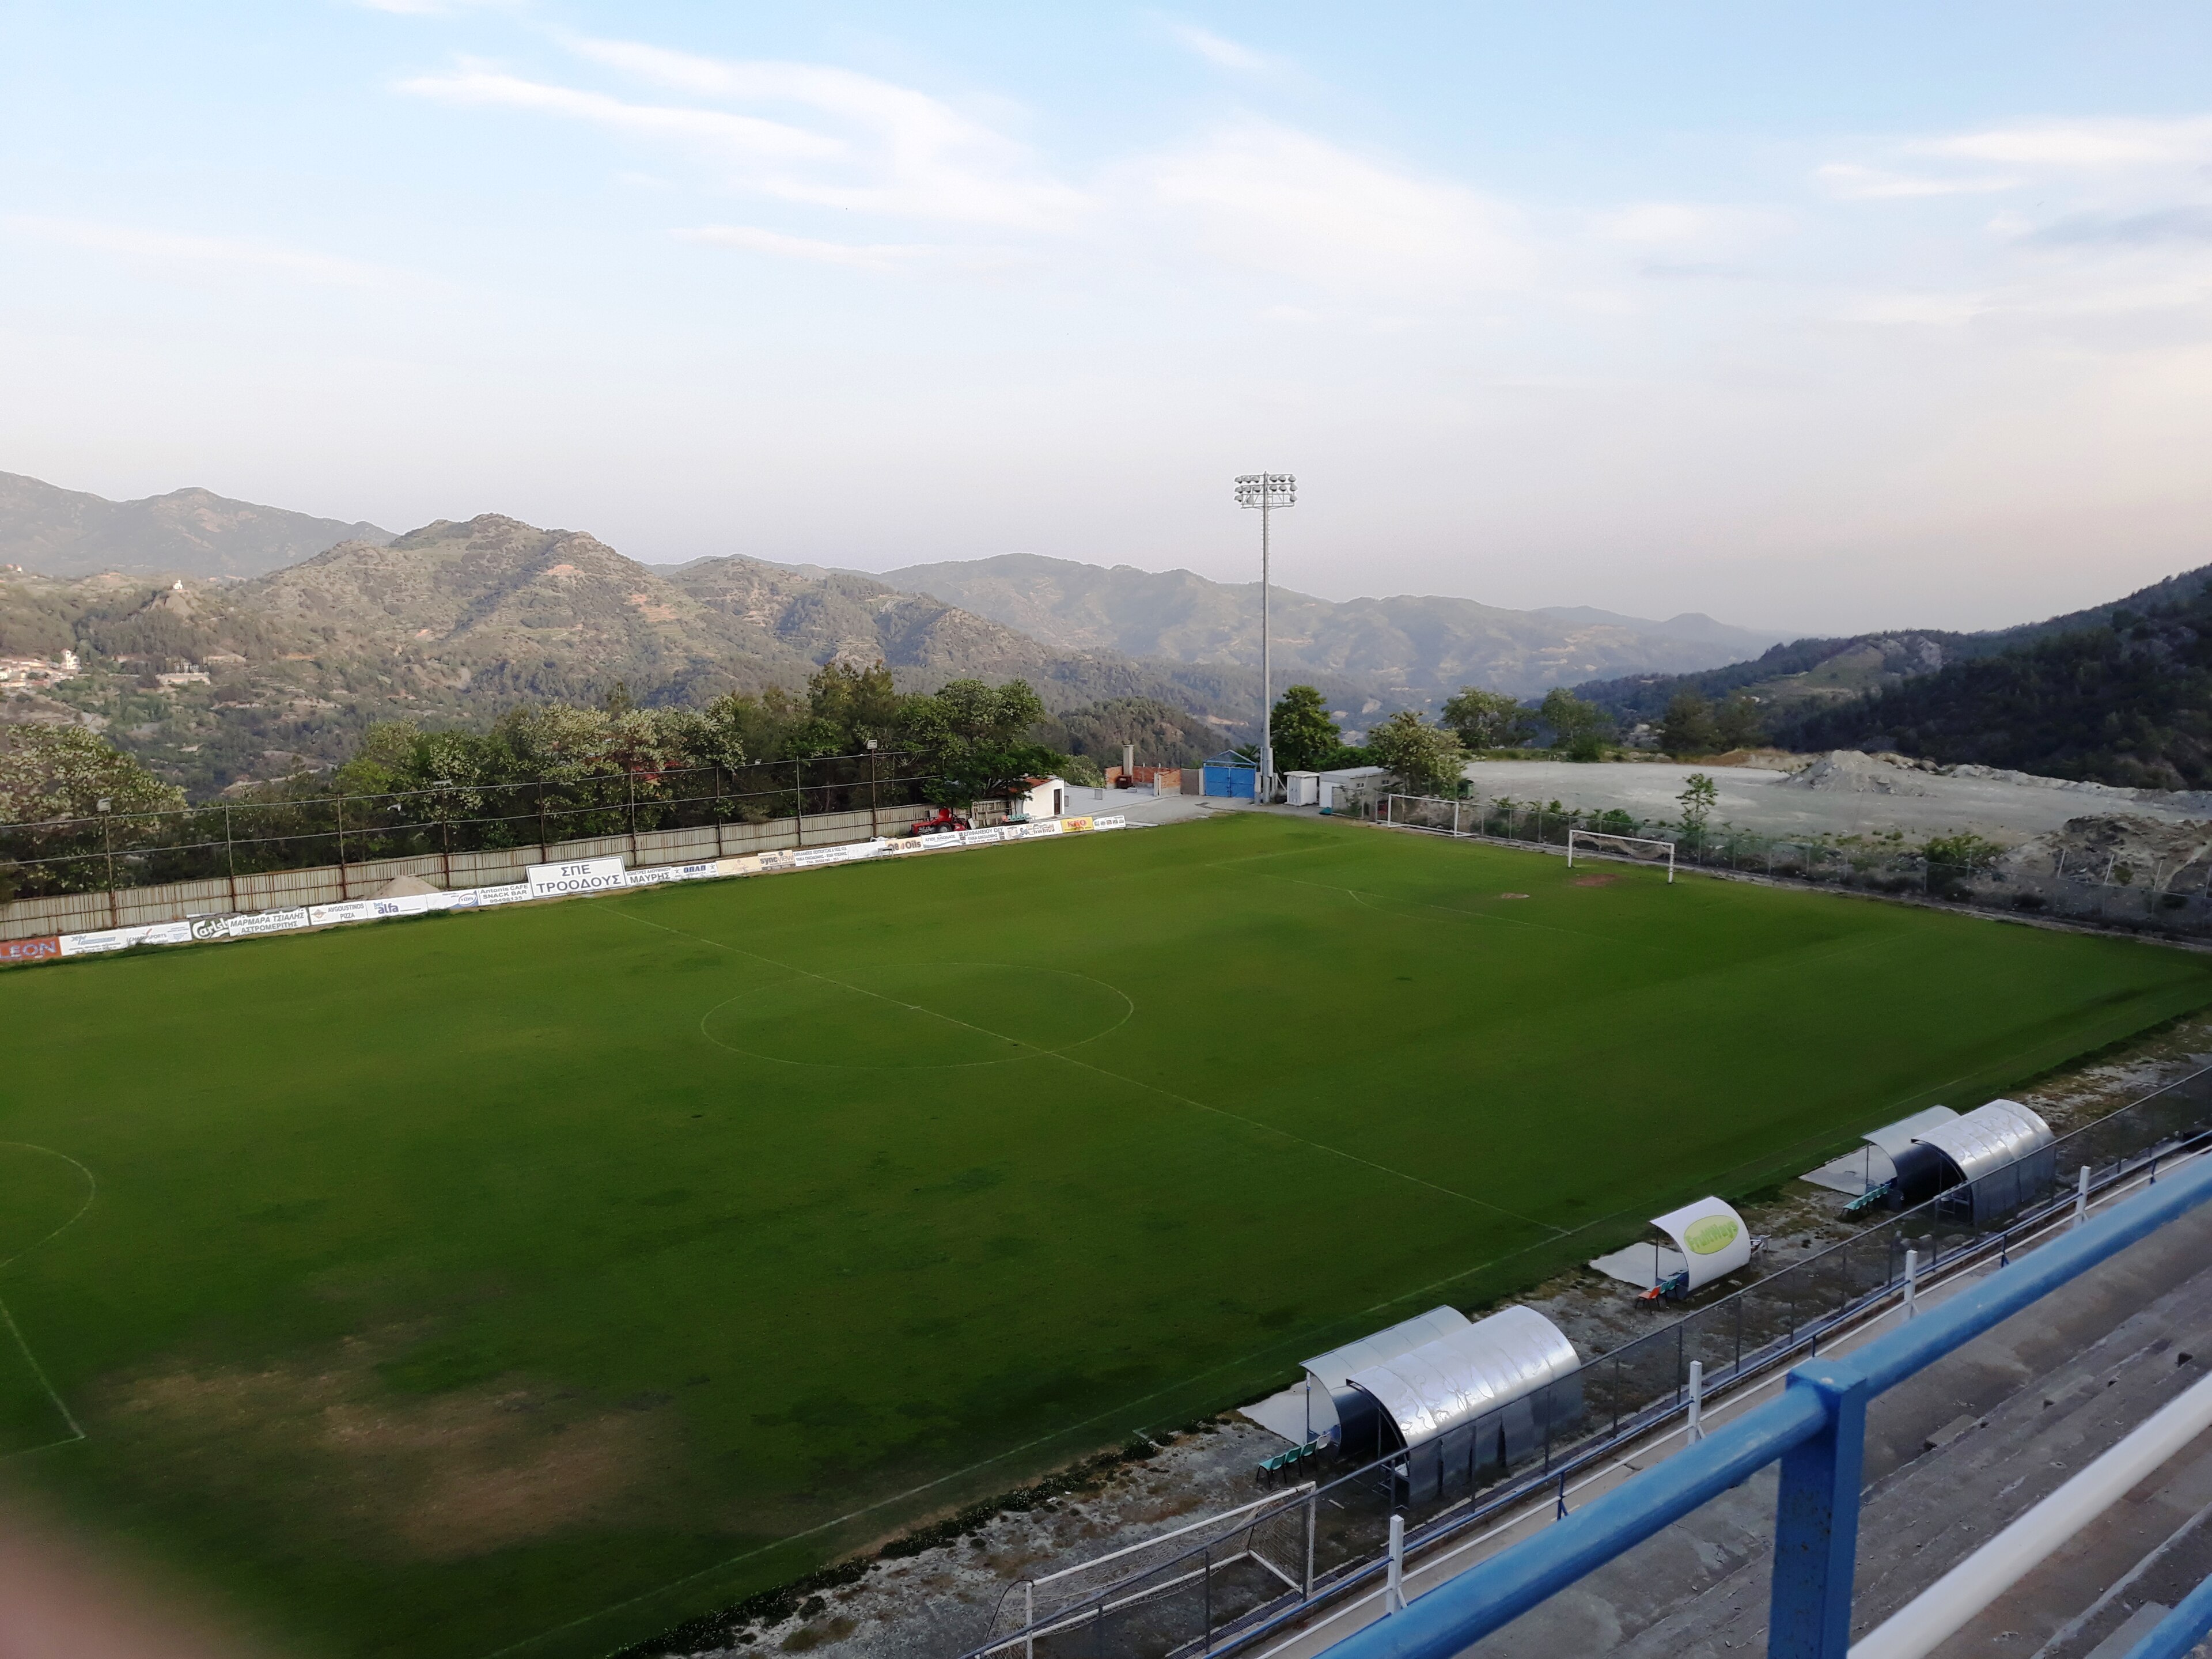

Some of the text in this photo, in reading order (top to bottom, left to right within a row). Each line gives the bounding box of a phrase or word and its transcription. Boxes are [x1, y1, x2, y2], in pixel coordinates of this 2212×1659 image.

[905, 840, 921, 849] Oils
[560, 864, 591, 877] ΣΠΕ
[536, 874, 622, 893] ΤΡΟΟΔΟΥΣ
[630, 872, 671, 884] ΜΑΥΡΗΣ
[480, 886, 509, 894] Antonis
[378, 903, 399, 915] alfa
[230, 912, 305, 927] ΜΑΡΜΑΡΑ ΤΣΙΑΛΗΣ
[241, 921, 298, 933] ΑΣΤΡΟΜΕΡΙΤΗΣ
